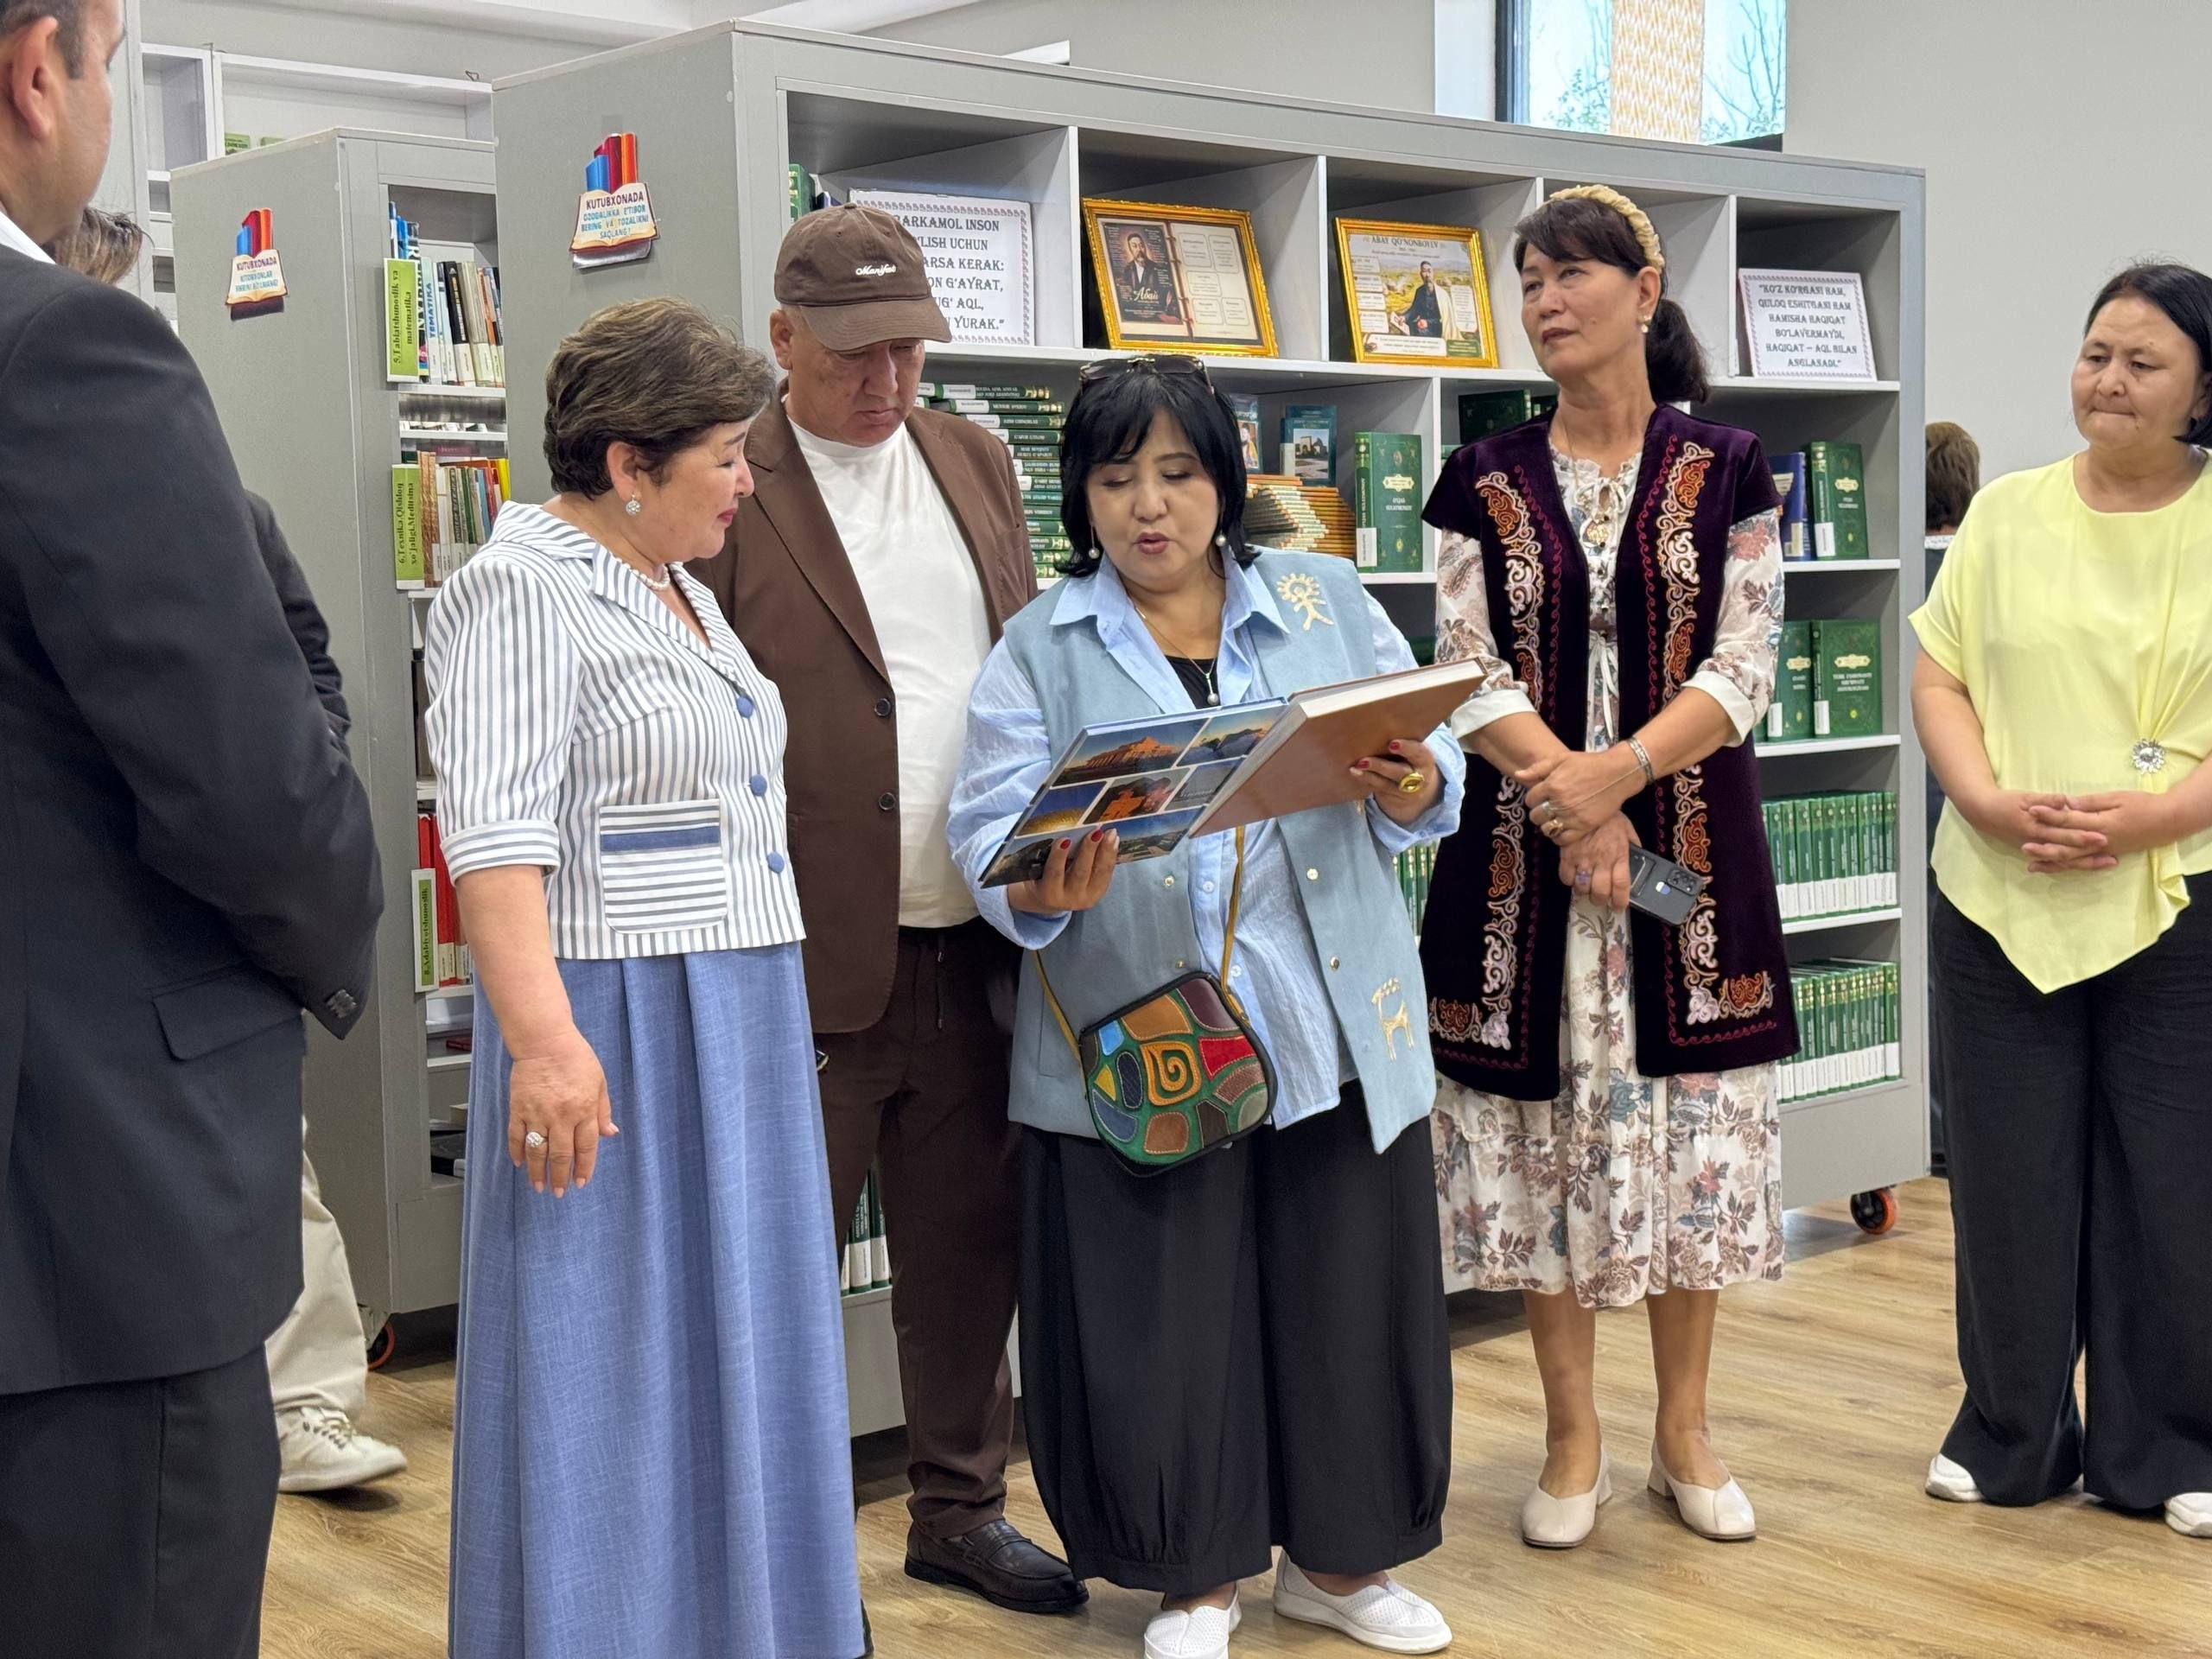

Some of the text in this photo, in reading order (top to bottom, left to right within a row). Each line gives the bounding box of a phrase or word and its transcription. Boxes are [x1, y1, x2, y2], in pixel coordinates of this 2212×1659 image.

[586, 191, 645, 210] KUTUBXONADA
[965, 219, 1000, 232] INSON
[950, 238, 988, 251] UCHUN
[923, 256, 1004, 271] ARSA KERAK:
[957, 297, 984, 311] AQL,
[1815, 344, 1832, 353] AQL
